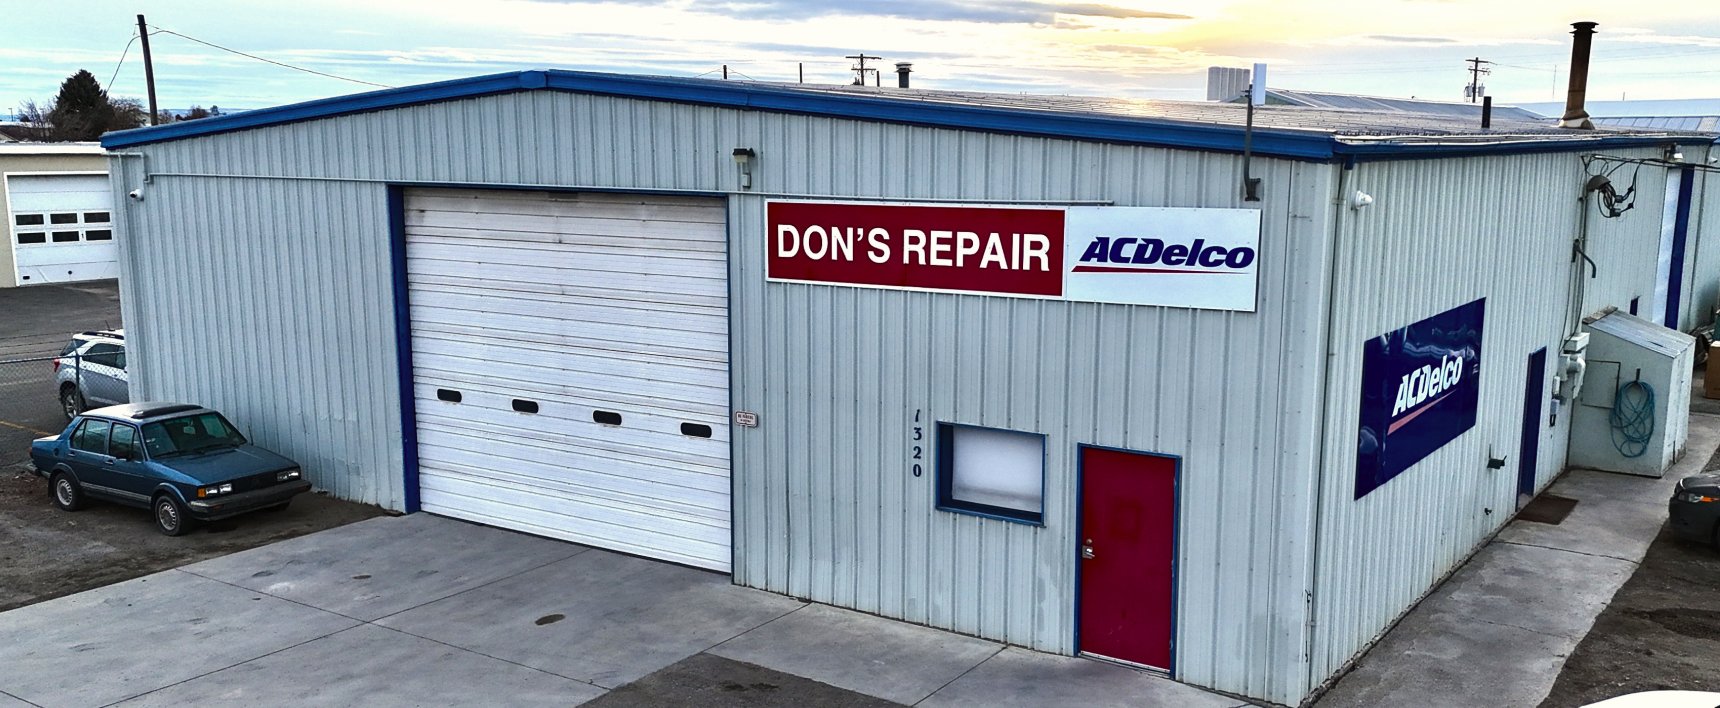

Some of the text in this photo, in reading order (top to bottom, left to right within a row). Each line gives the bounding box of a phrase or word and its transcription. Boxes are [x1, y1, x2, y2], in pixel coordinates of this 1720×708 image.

[777, 224, 1050, 272] DON’S REPAIR
[1078, 236, 1255, 268] ACDelco
[1392, 355, 1463, 417] ACDelco
[913, 409, 922, 477] 1320
